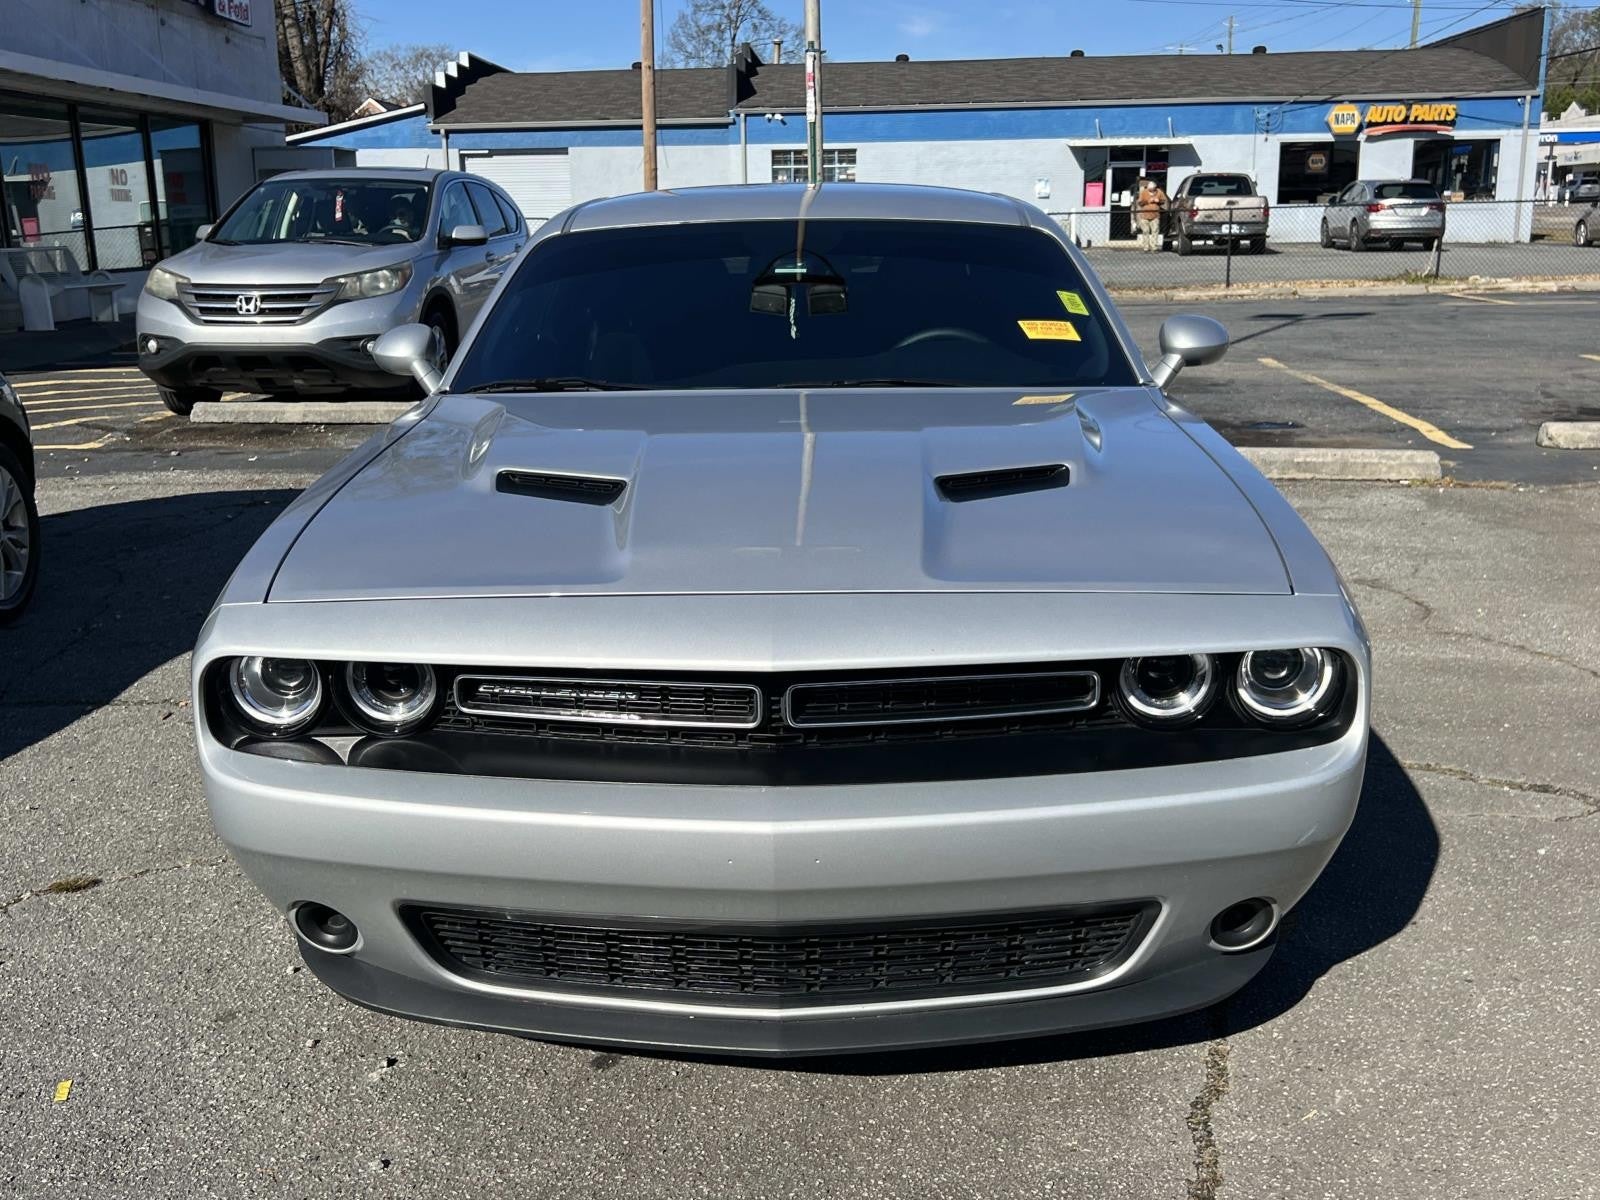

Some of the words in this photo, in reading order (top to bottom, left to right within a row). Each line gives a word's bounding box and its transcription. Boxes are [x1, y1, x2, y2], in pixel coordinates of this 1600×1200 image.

[228, 0, 249, 21] Fold
[1334, 112, 1356, 126] NAPA
[1364, 105, 1407, 123] AUTO
[1410, 104, 1457, 122] PARTS
[111, 168, 128, 186] NO
[477, 684, 638, 700] CHALLENGER
